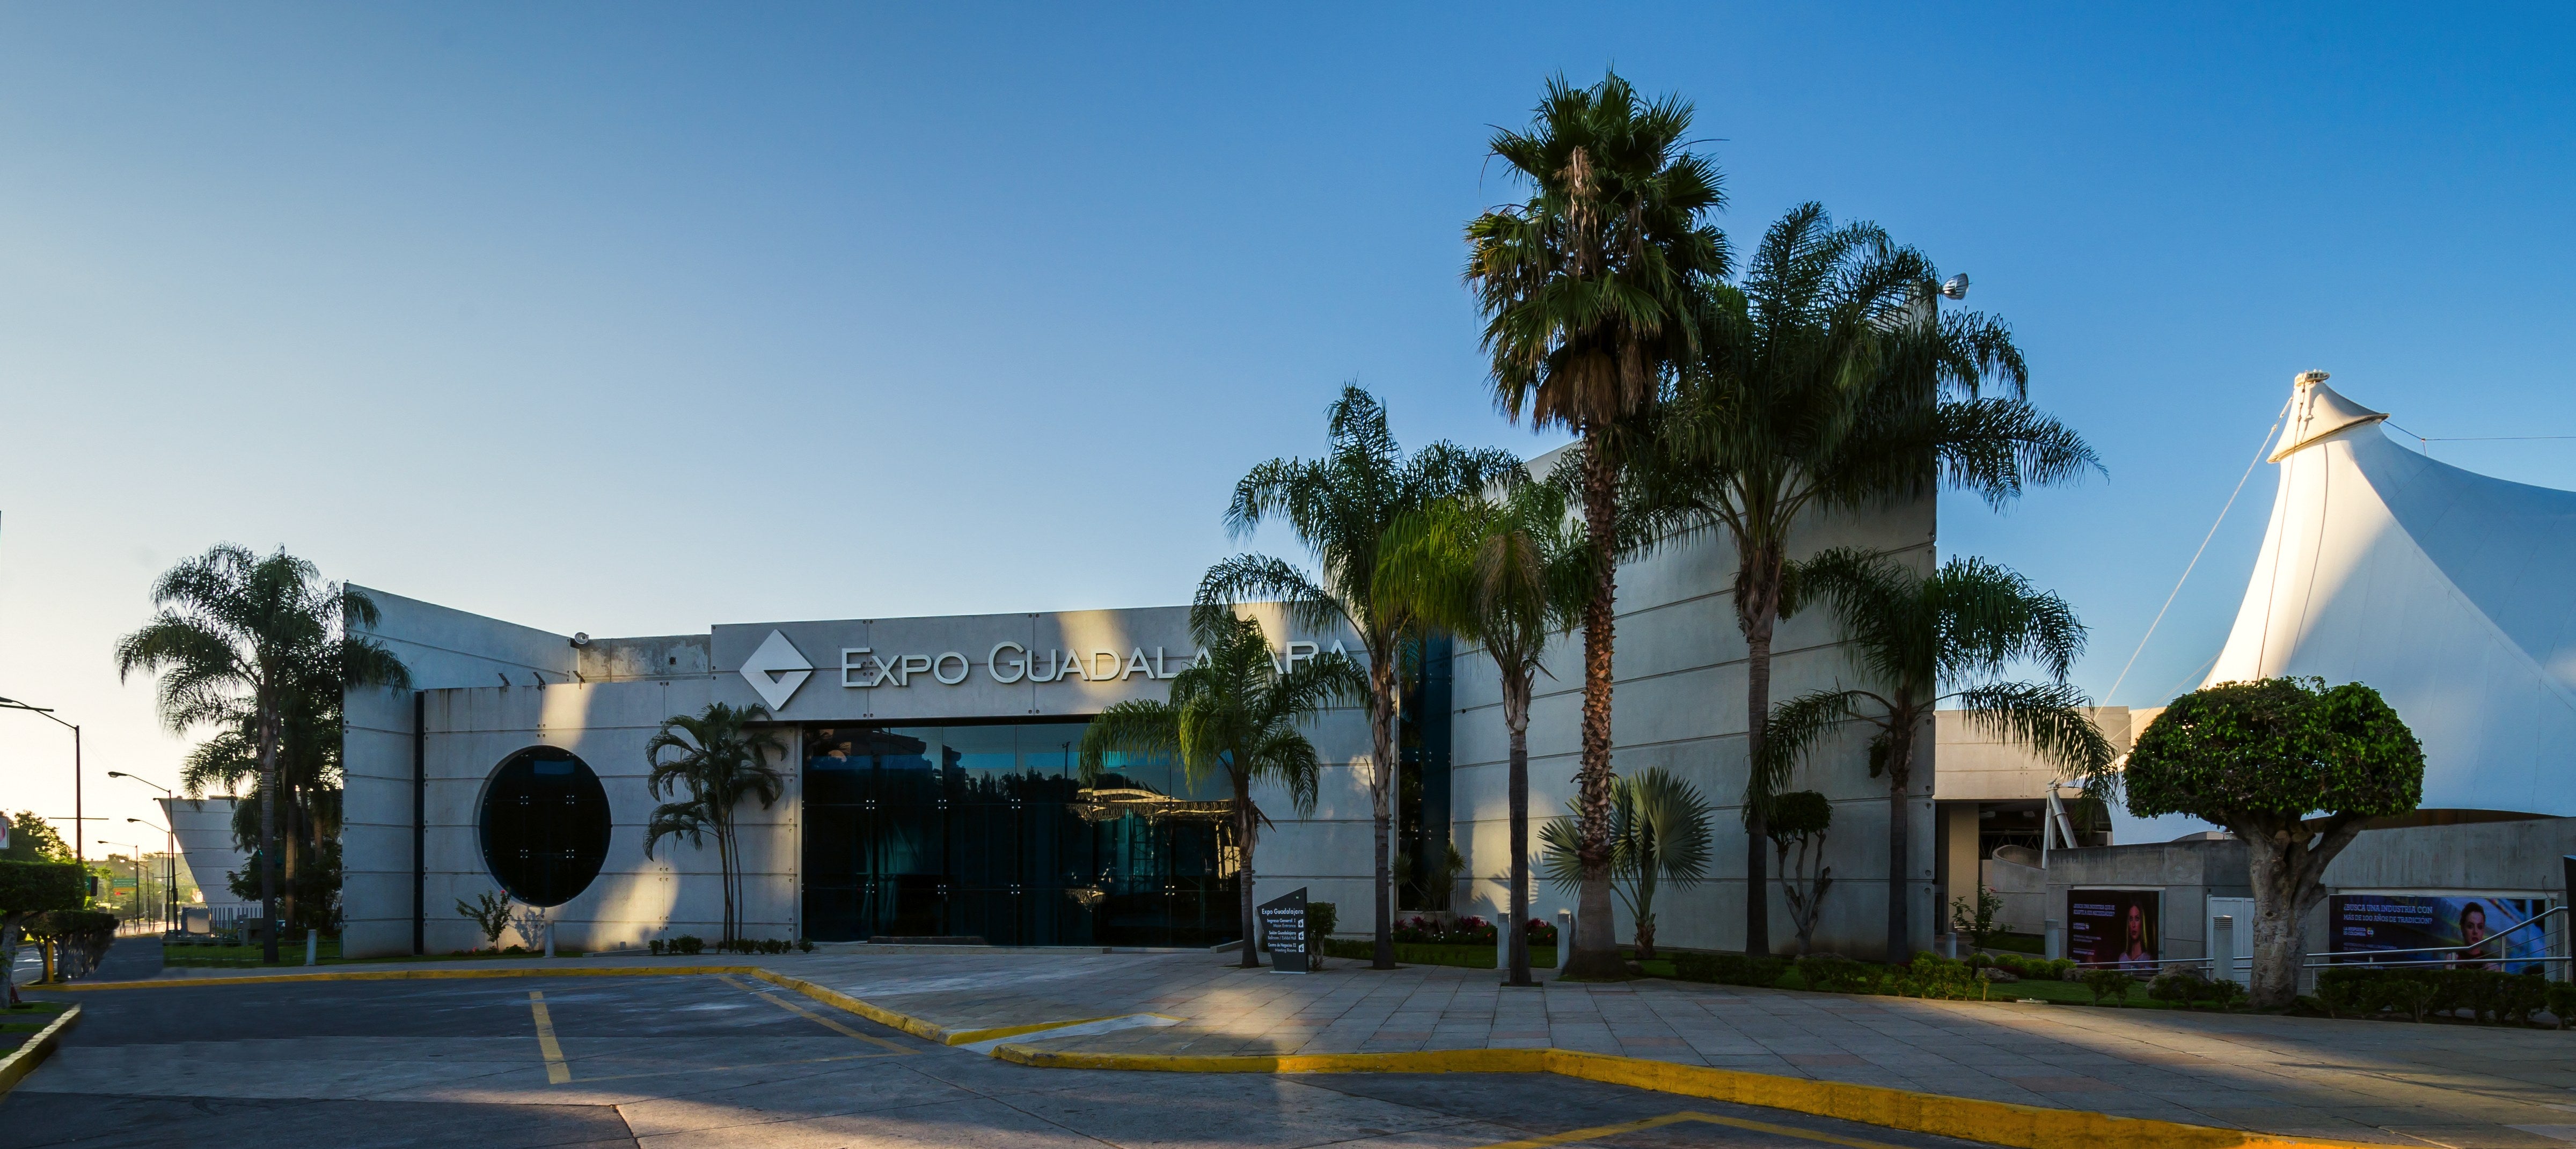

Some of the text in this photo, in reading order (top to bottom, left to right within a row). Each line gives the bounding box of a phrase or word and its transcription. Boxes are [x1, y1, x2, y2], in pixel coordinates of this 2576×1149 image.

[1262, 908, 1304, 916] Expo Guadalajara
[2381, 904, 2416, 913] INDUSTRIA
[2374, 913, 2388, 922] AÑOS
